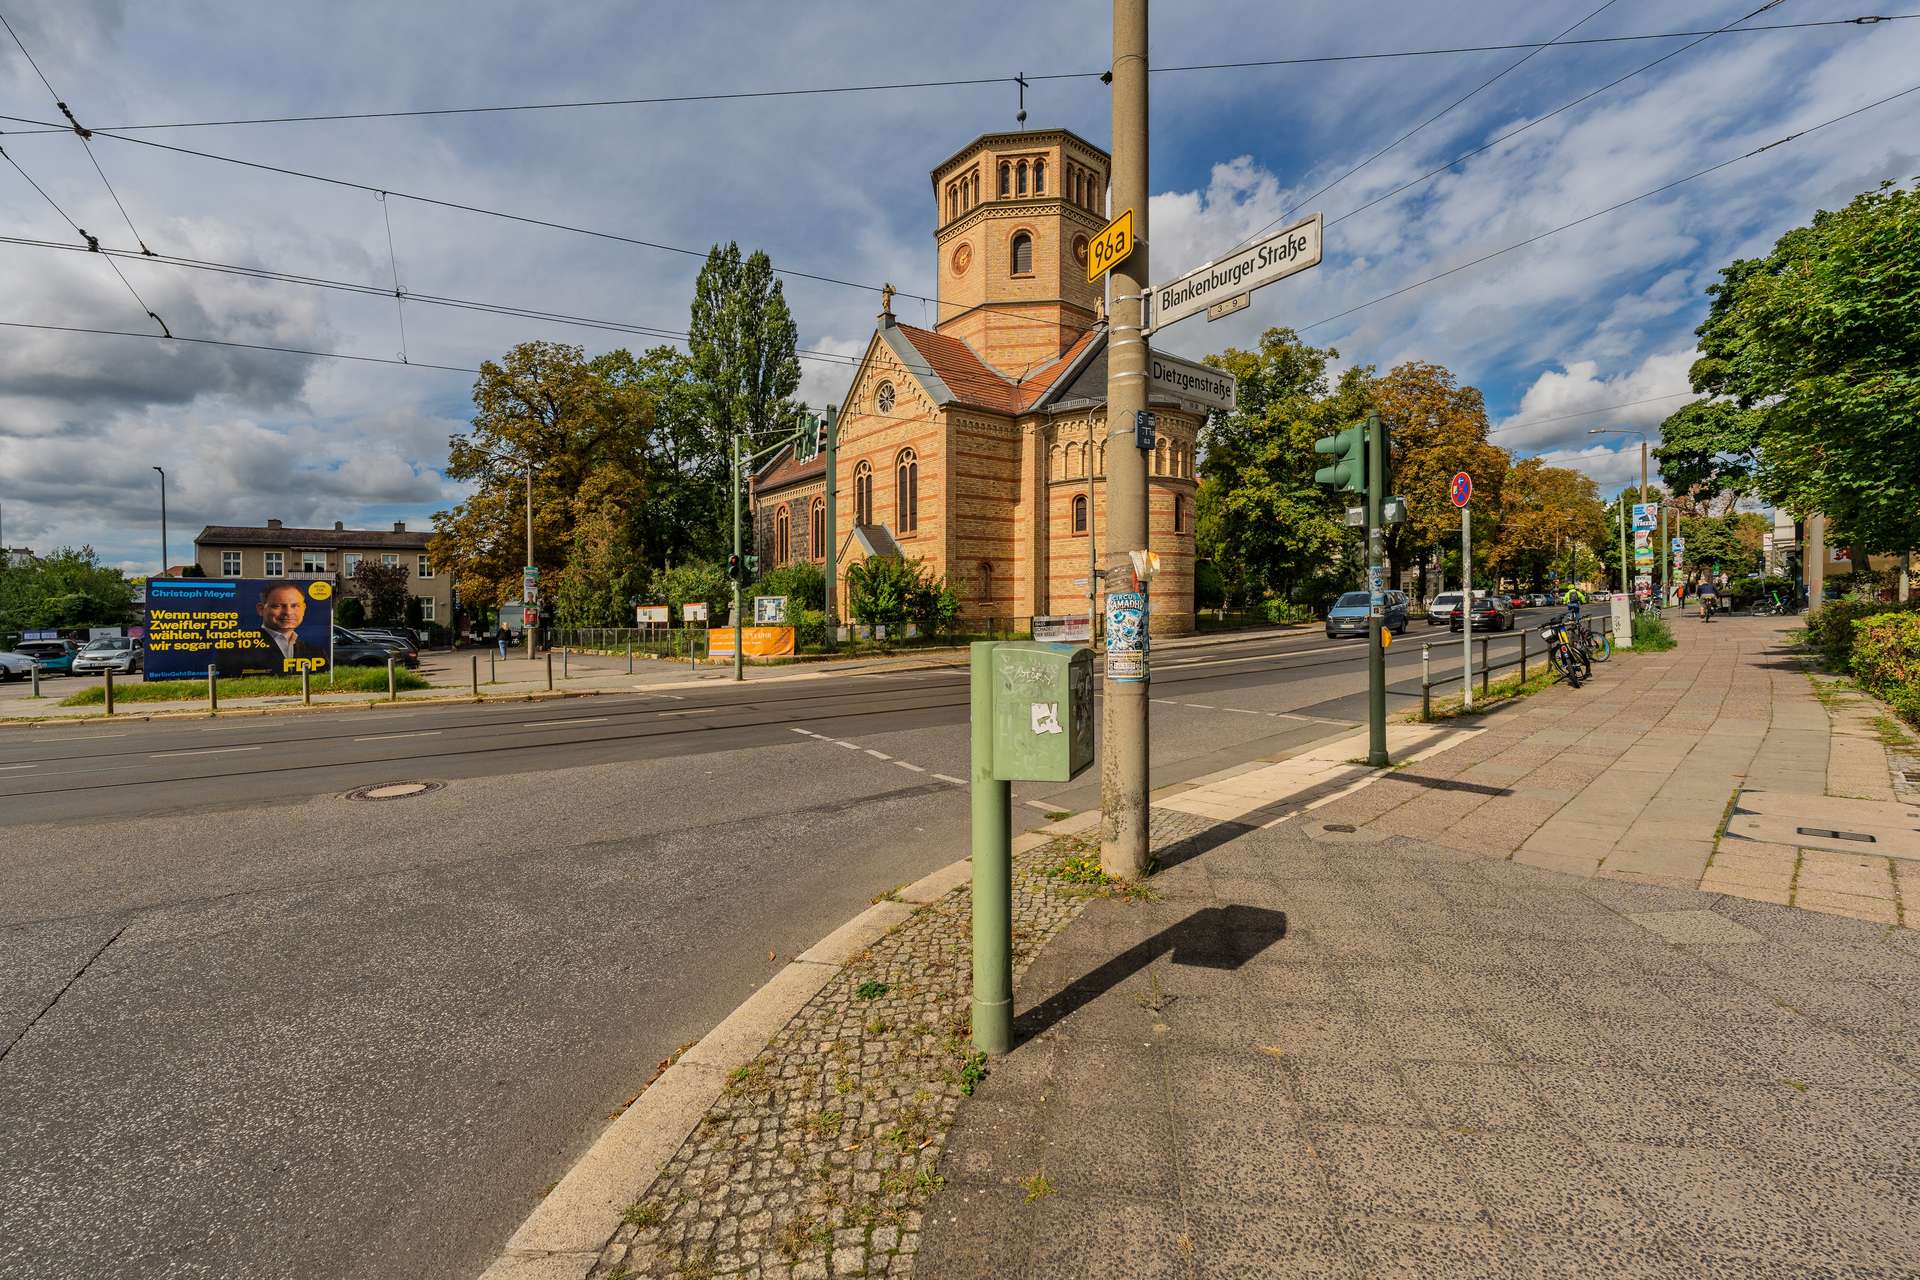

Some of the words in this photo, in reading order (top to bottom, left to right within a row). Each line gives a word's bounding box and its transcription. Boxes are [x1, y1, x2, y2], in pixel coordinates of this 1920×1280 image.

[1095, 231, 1125, 268] 96a
[1162, 257, 1256, 311] Blankenburger
[1258, 234, 1307, 269] Straße
[1216, 304, 1223, 313] 3
[1232, 299, 1238, 308] 9
[1153, 361, 1231, 400] Dietzgenstraße
[151, 589, 202, 599] Christoph
[204, 590, 236, 599] Meyer
[150, 610, 190, 620] Wenn
[193, 611, 239, 620] unsere
[150, 620, 207, 630] Zweifler
[210, 620, 238, 630] FDP
[150, 630, 203, 641] wählen,
[206, 629, 261, 639] knacken
[149, 641, 171, 651] wir
[173, 641, 213, 652] sogar
[214, 639, 235, 649] die
[237, 639, 251, 648] 10
[253, 638, 270, 649] %.
[283, 657, 326, 673] FDP
